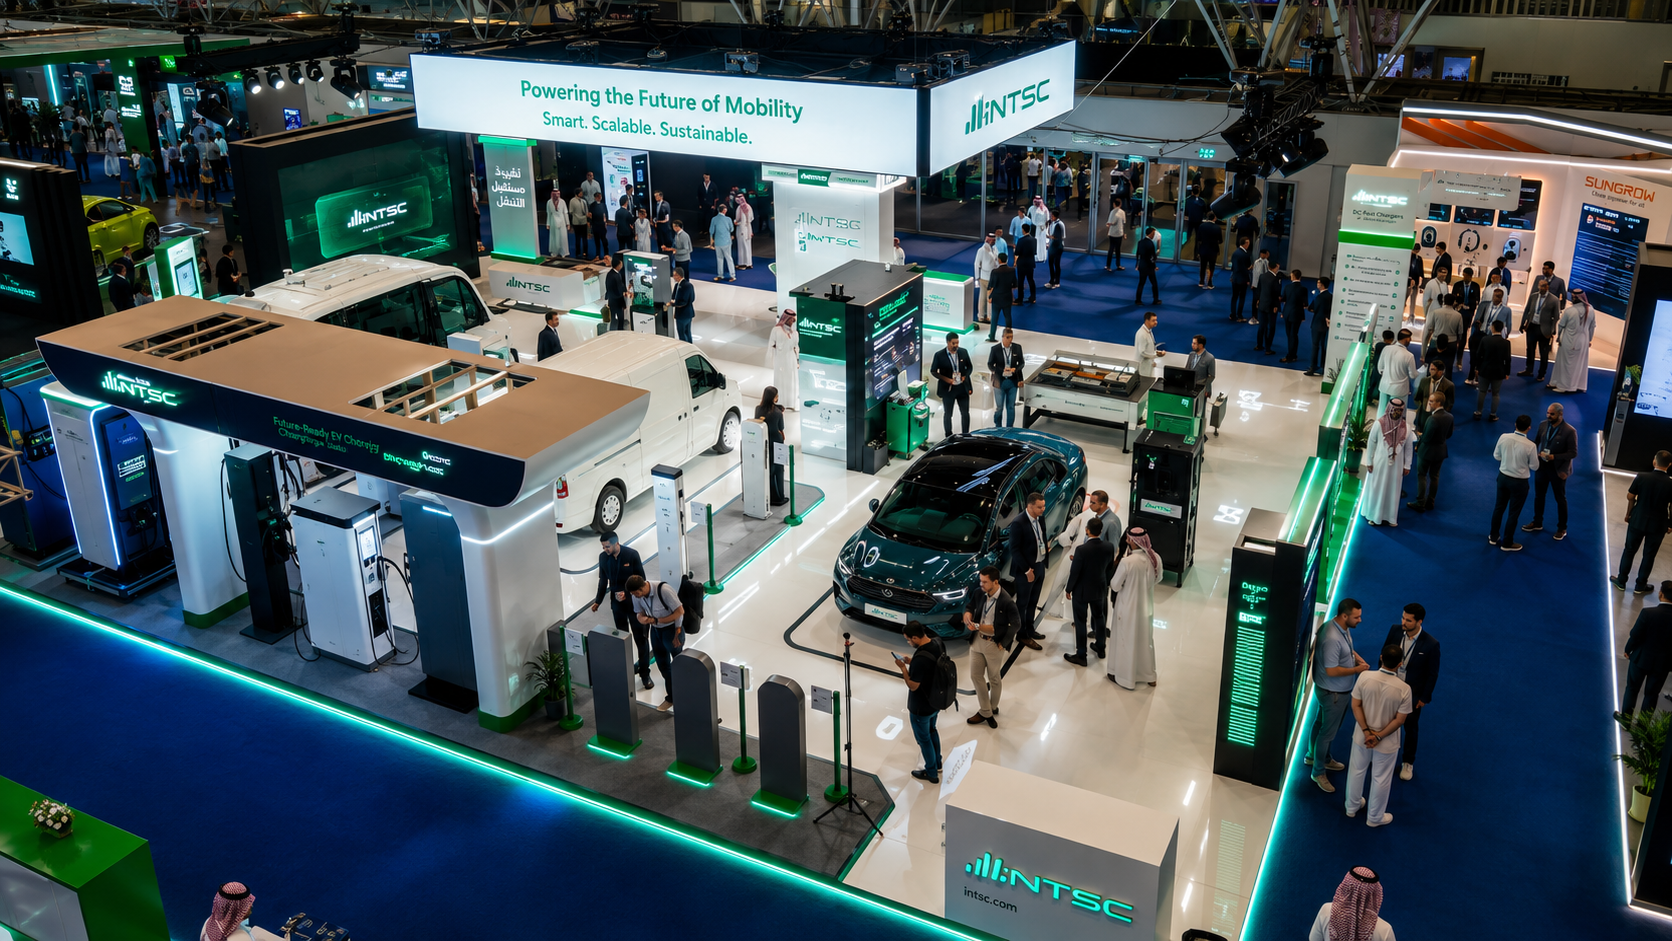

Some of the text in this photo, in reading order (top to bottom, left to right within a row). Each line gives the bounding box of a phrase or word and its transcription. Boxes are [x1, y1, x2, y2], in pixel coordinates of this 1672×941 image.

[521, 80, 803, 124] Powering the Future of Mobility
[543, 111, 752, 145] Smart. Scalable. Sustainable.
[1585, 176, 1655, 202] SUNGROW
[963, 886, 1018, 913] intsc.com
